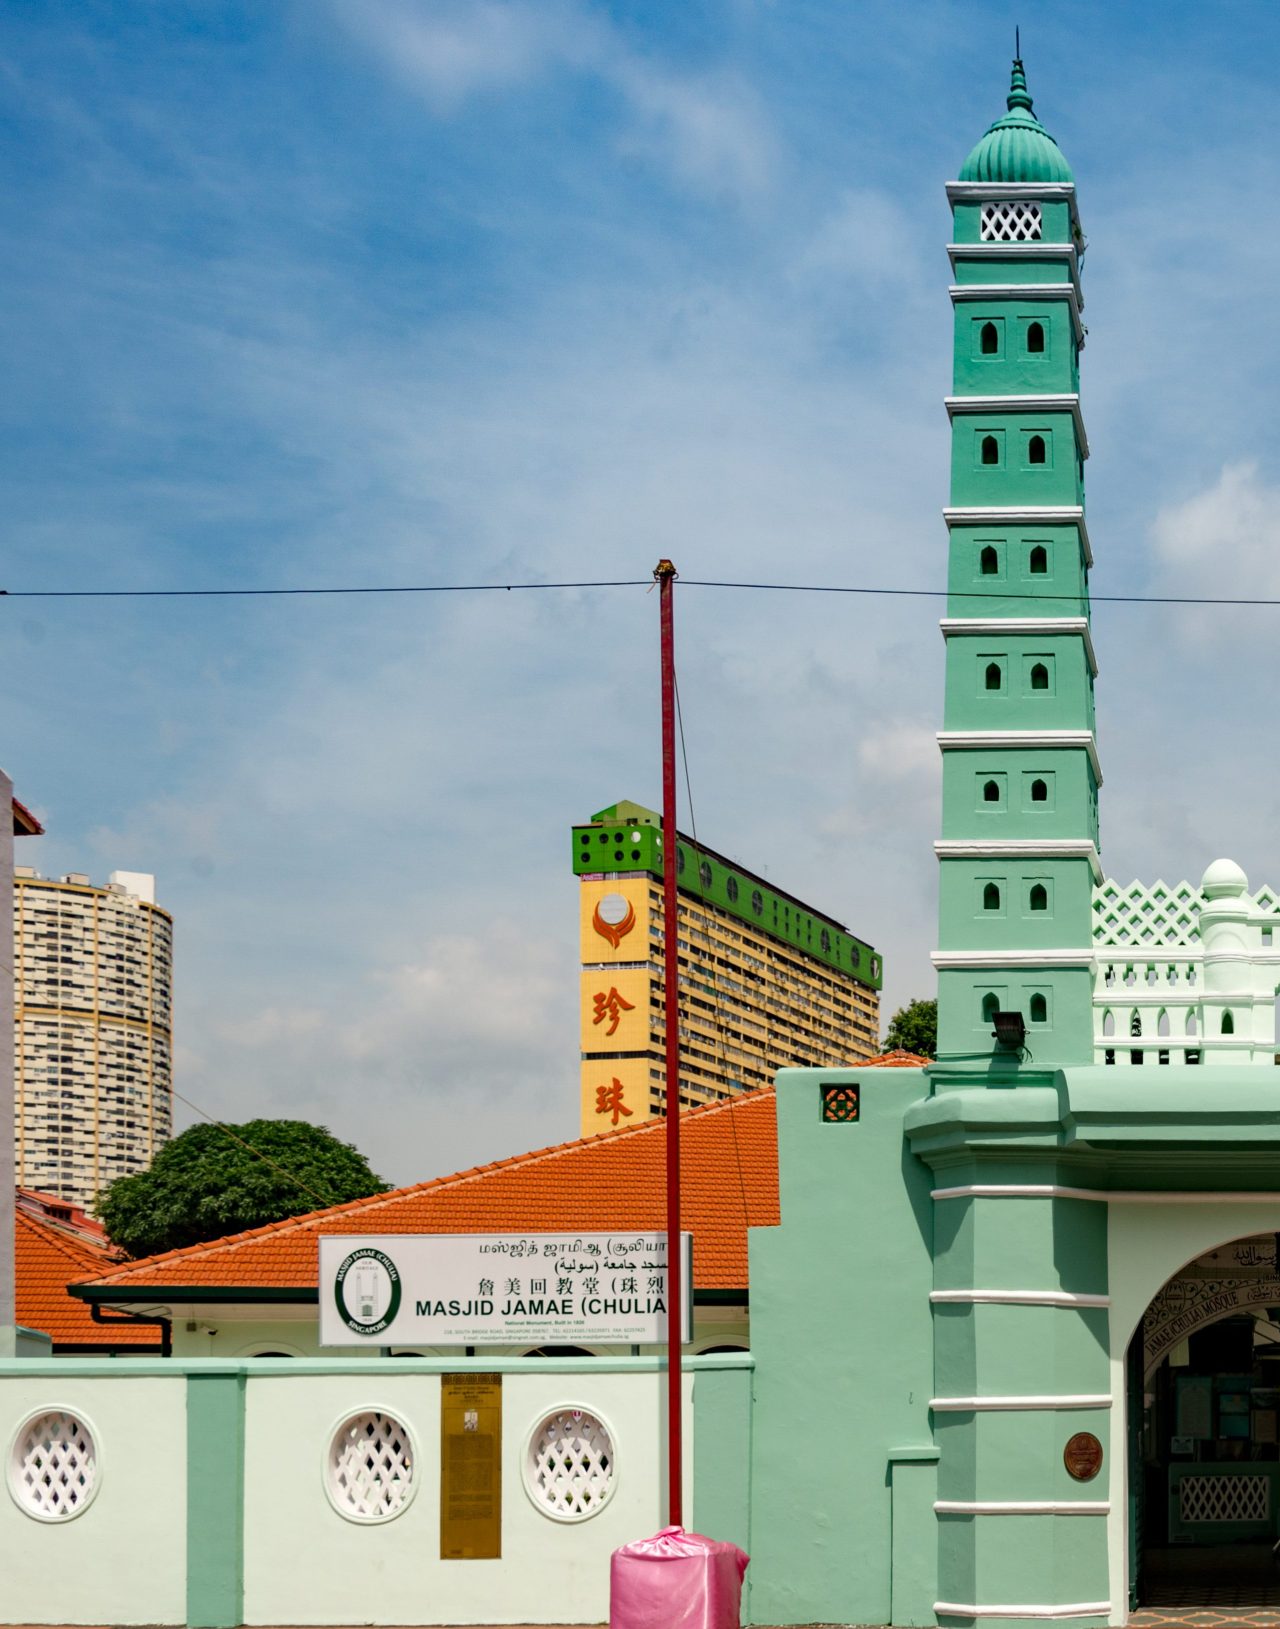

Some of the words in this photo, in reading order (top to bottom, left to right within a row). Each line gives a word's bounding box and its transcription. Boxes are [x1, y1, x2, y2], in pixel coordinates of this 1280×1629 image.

[336, 1257, 353, 1281] MASJID
[352, 1249, 376, 1260] JAMAE
[376, 1253, 398, 1281] (CHULIA)
[415, 1301, 494, 1316] MASJID
[501, 1299, 574, 1316] JAMAE
[348, 1320, 387, 1334] SINGAPORE
[1145, 1332, 1172, 1356] JAMAE
[1201, 1291, 1240, 1317] MOSQUE
